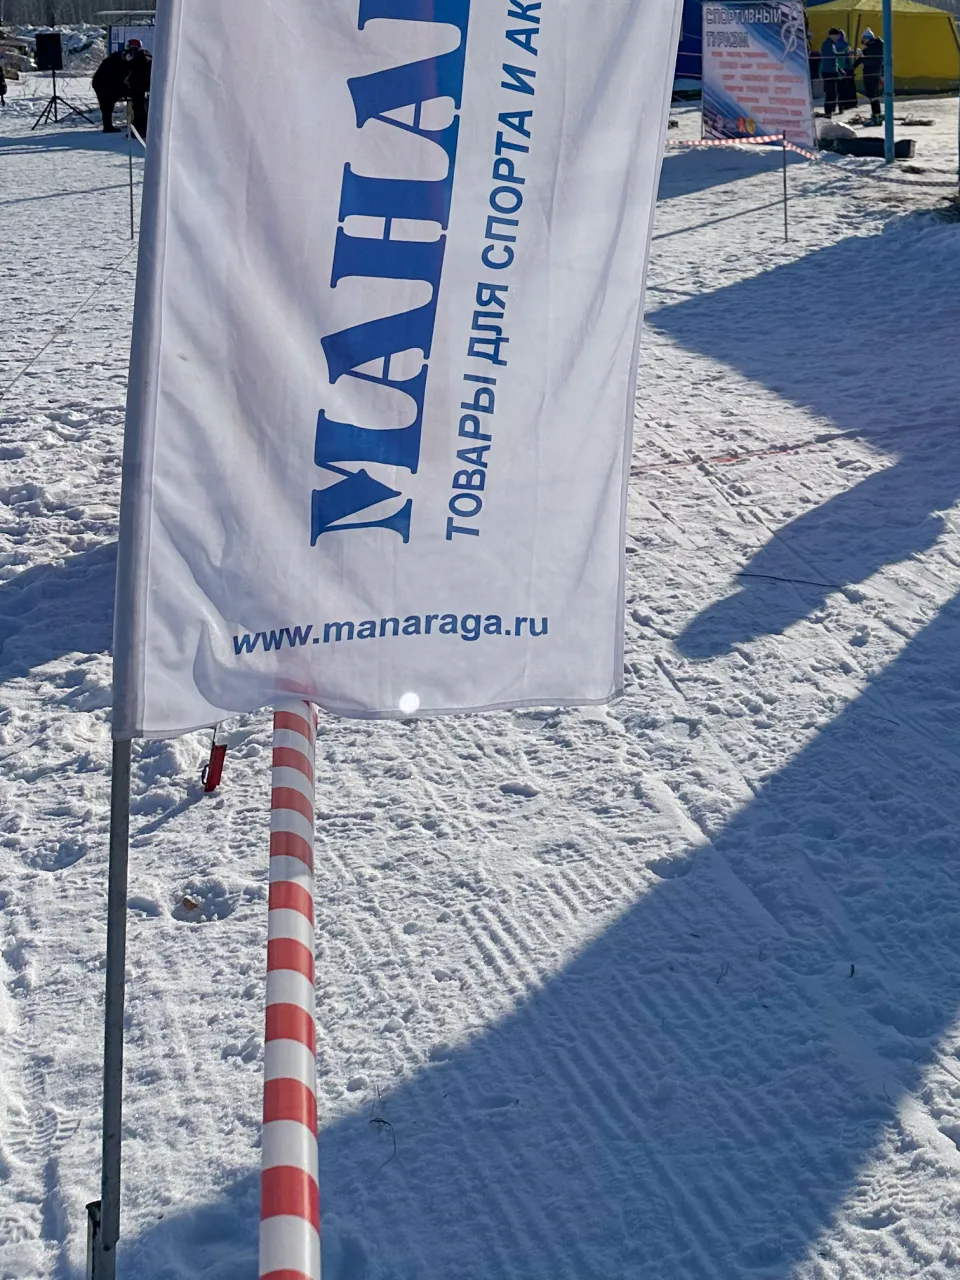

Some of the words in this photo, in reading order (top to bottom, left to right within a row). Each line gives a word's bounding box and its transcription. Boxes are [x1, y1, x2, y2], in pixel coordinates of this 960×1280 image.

[501, 63, 537, 96] И
[481, 108, 534, 269] СПОРТА
[467, 282, 509, 366] ДЛЯ
[446, 373, 497, 540] ТОВАРЫ
[232, 612, 549, 656] www.manaraga.ru
